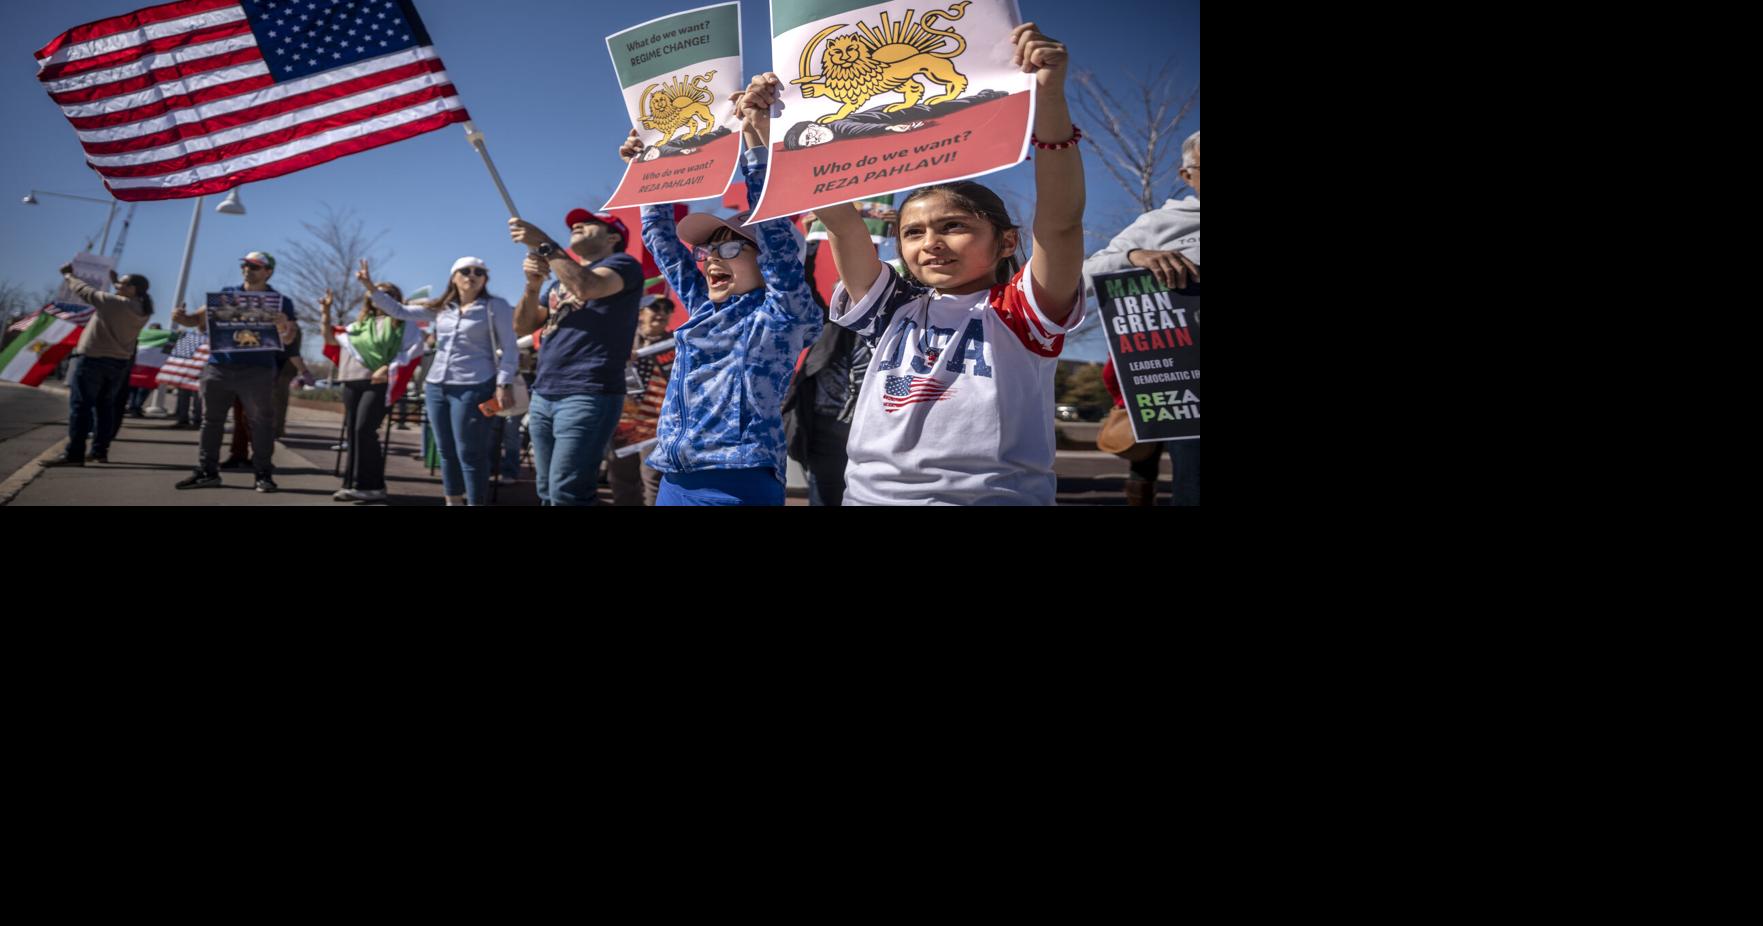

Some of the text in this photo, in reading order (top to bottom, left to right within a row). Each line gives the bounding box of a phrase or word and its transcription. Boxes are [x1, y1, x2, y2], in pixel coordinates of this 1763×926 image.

[626, 20, 710, 52] What do we want?
[630, 34, 710, 67] REGIME CHANGE!
[813, 130, 972, 177] Who do we want?
[642, 159, 714, 181] Who do we want?
[813, 151, 958, 195] REZA PAHLAVI!
[638, 175, 704, 193] REZA PAHLAVI!
[1114, 291, 1173, 316] IRAN
[1112, 308, 1188, 335] GREAT
[1120, 327, 1193, 353] AGAIN
[1129, 357, 1175, 372] LEADER OF
[1133, 370, 1191, 386] DEMOCRATIC
[1136, 388, 1200, 408] REZA
[1140, 404, 1200, 423] PAHL
